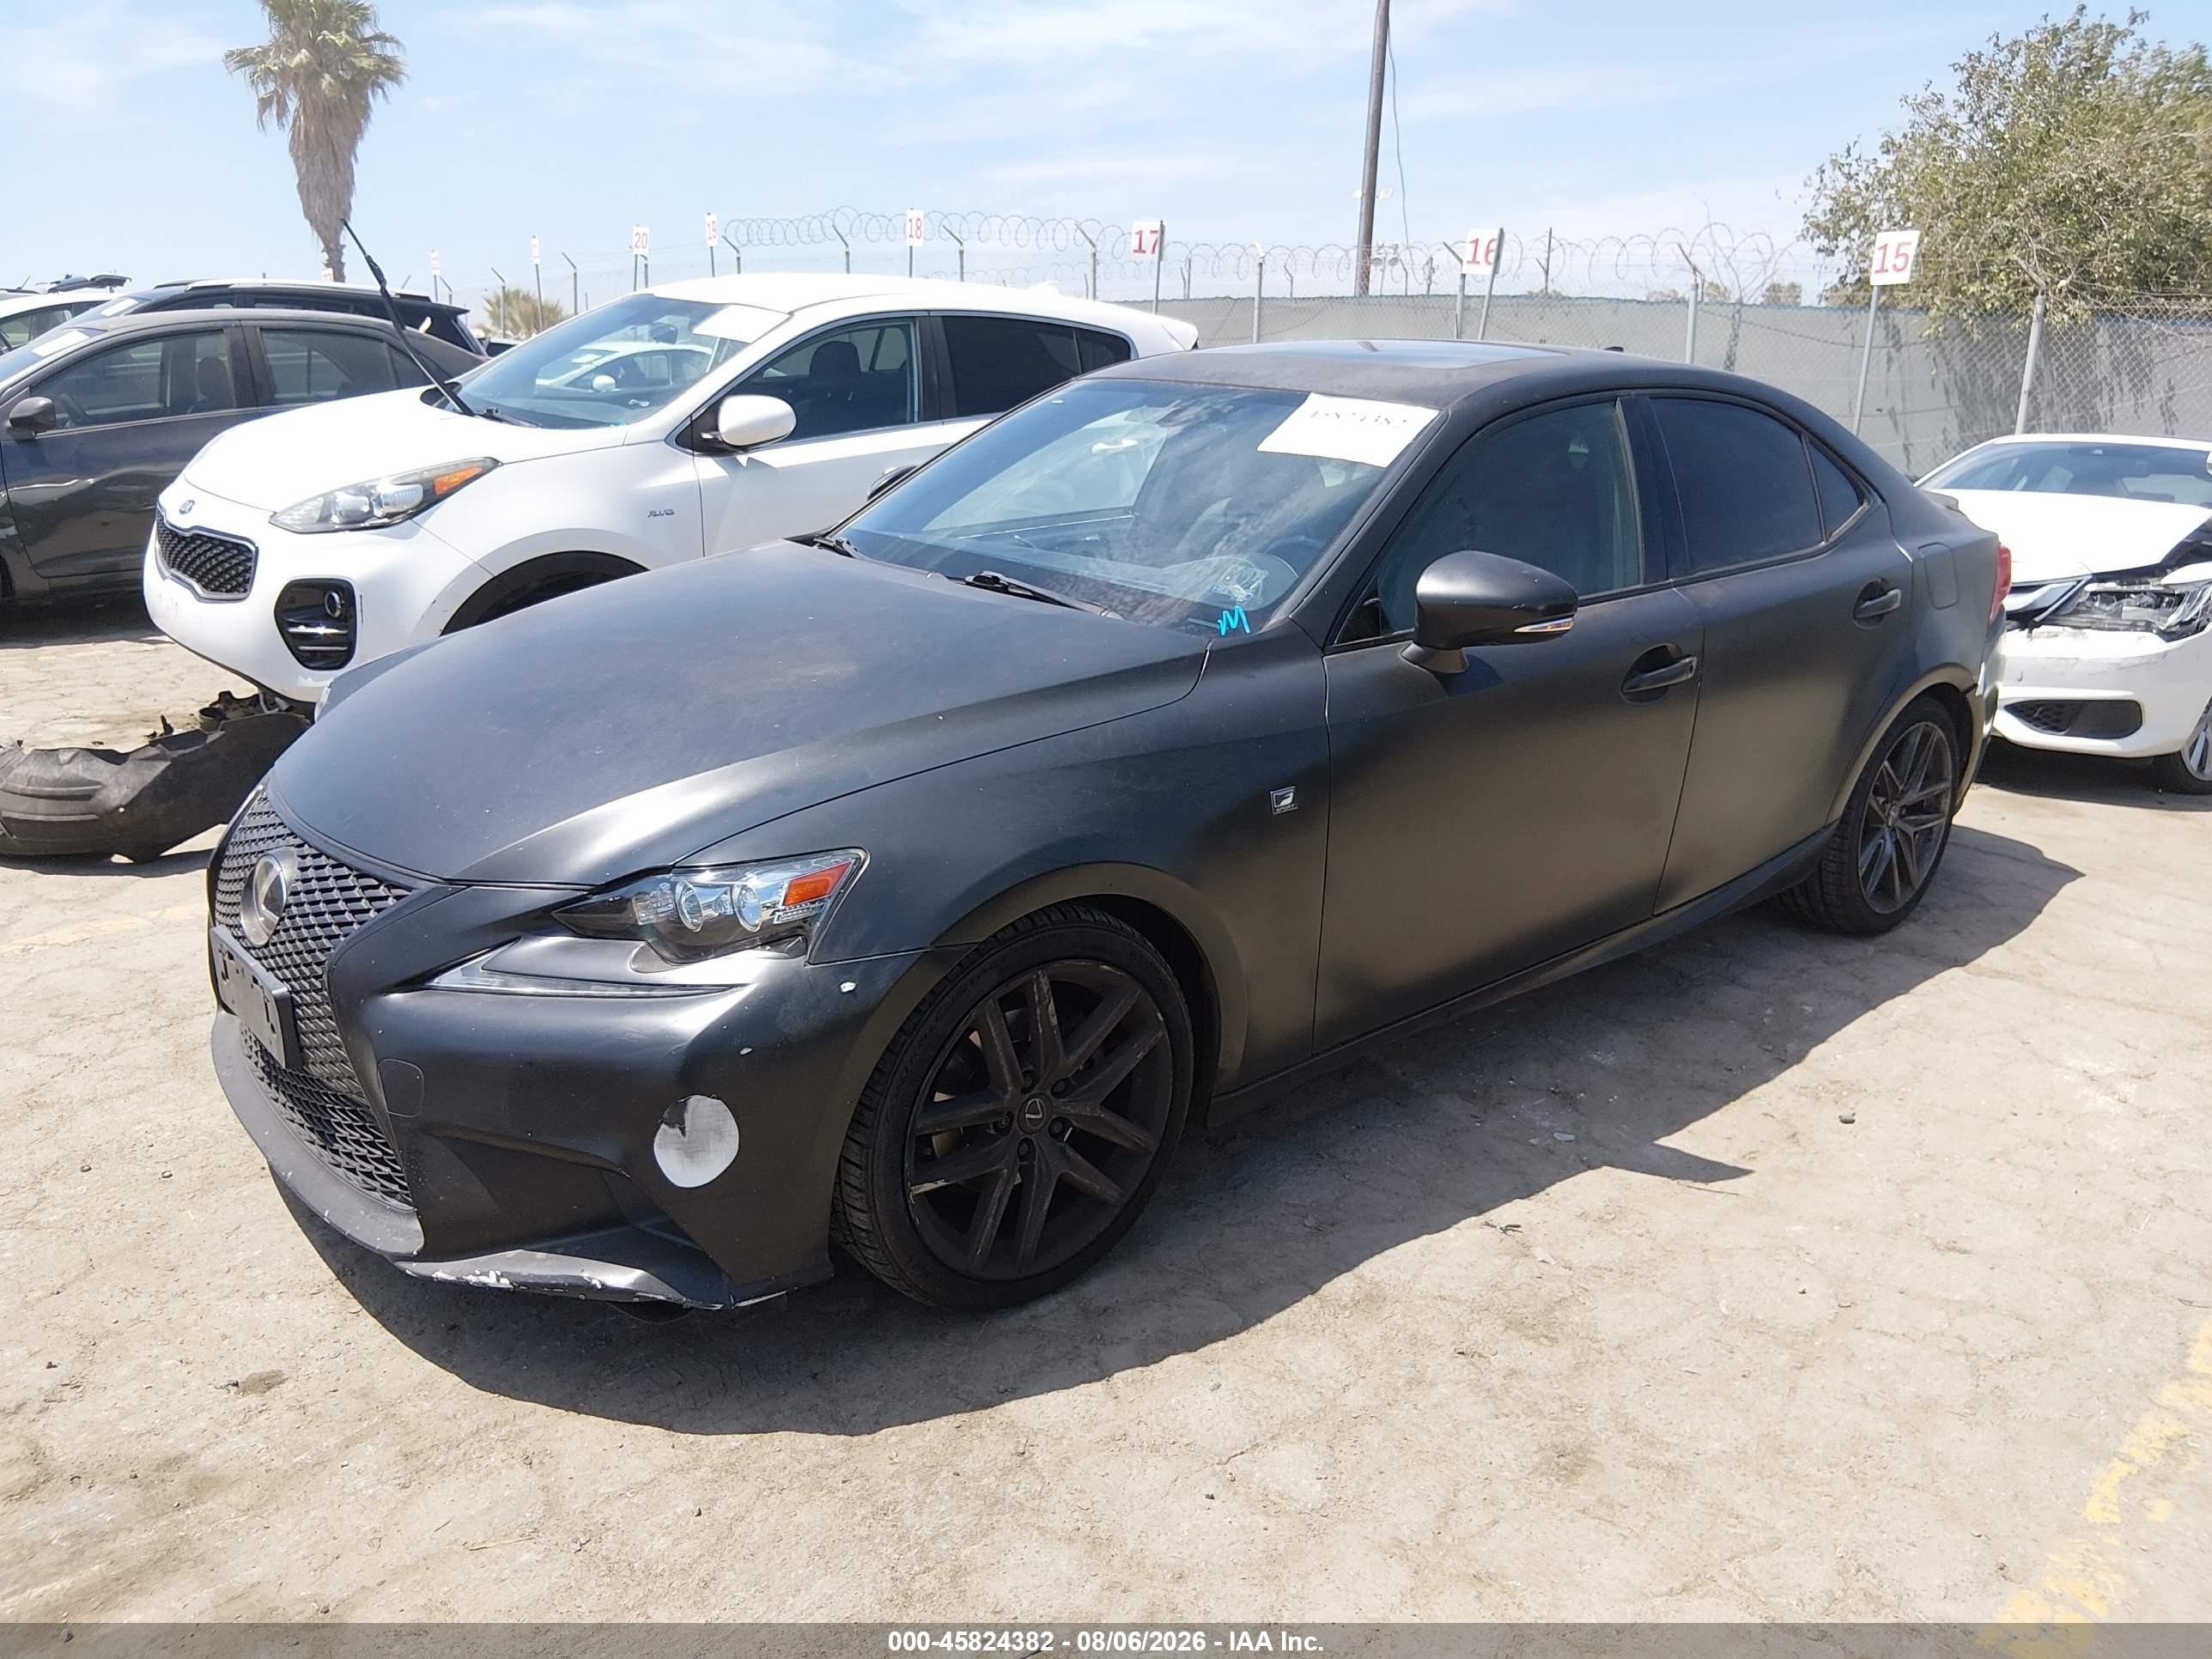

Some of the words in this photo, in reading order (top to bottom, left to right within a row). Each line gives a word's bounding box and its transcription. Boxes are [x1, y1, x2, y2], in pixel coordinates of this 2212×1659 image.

[635, 232, 648, 249] 20
[707, 221, 718, 240] 19
[908, 217, 922, 240] 18
[1133, 229, 1160, 255] 17
[1875, 241, 1912, 274] 15
[1217, 604, 1250, 636] M
